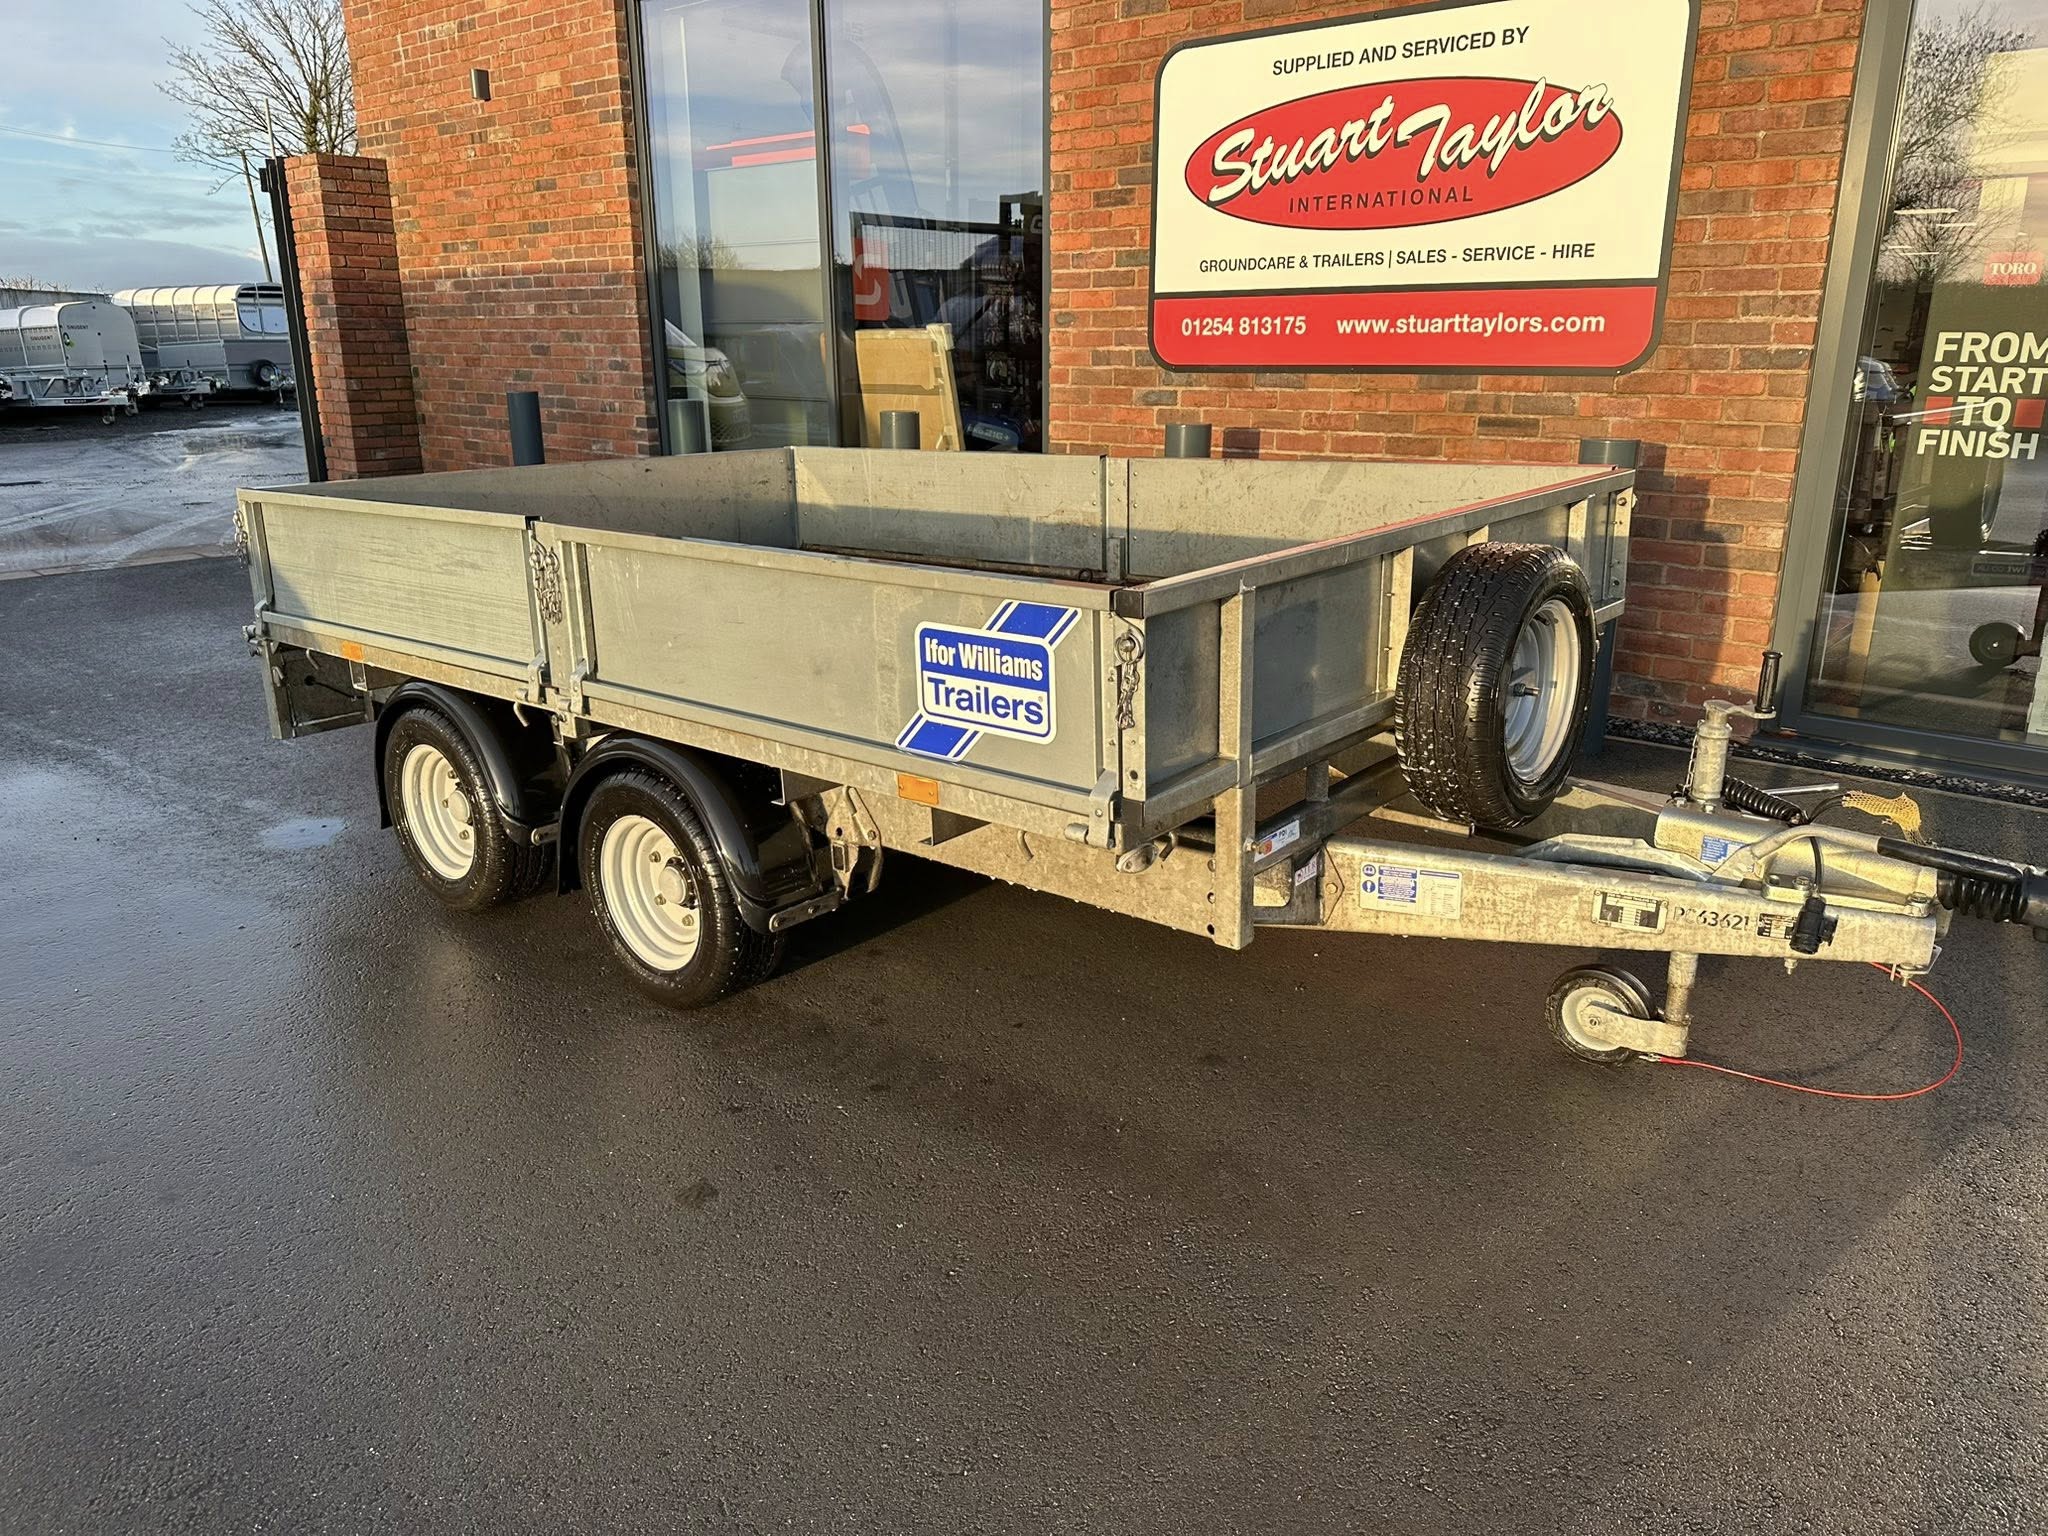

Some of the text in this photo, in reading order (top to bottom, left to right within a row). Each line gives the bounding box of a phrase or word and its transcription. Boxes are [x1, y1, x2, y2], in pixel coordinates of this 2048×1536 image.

[1272, 25, 1530, 76] SUPPLIED AND SERVICED BY
[1208, 77, 1614, 204] Stuart Taylor
[1288, 186, 1474, 214] INTERNATIONAL
[1199, 255, 1296, 273] GROUNDCARE
[1299, 255, 1309, 269] &
[1313, 251, 1385, 268] TRAILERS
[1396, 248, 1447, 265] SALES
[1461, 245, 1536, 263] SERVICE
[1552, 242, 1596, 259] HIRE
[1990, 262, 2037, 275] TORO
[1181, 313, 1605, 337] 01254 813175 www.stuarttaylors.com
[1934, 331, 2048, 364] FROM
[1928, 366, 2048, 394] START
[1955, 396, 2012, 428] TO
[1917, 429, 2040, 460] FINISH
[925, 637, 1043, 681] Ifor Williams
[927, 677, 1044, 725] Trailers
